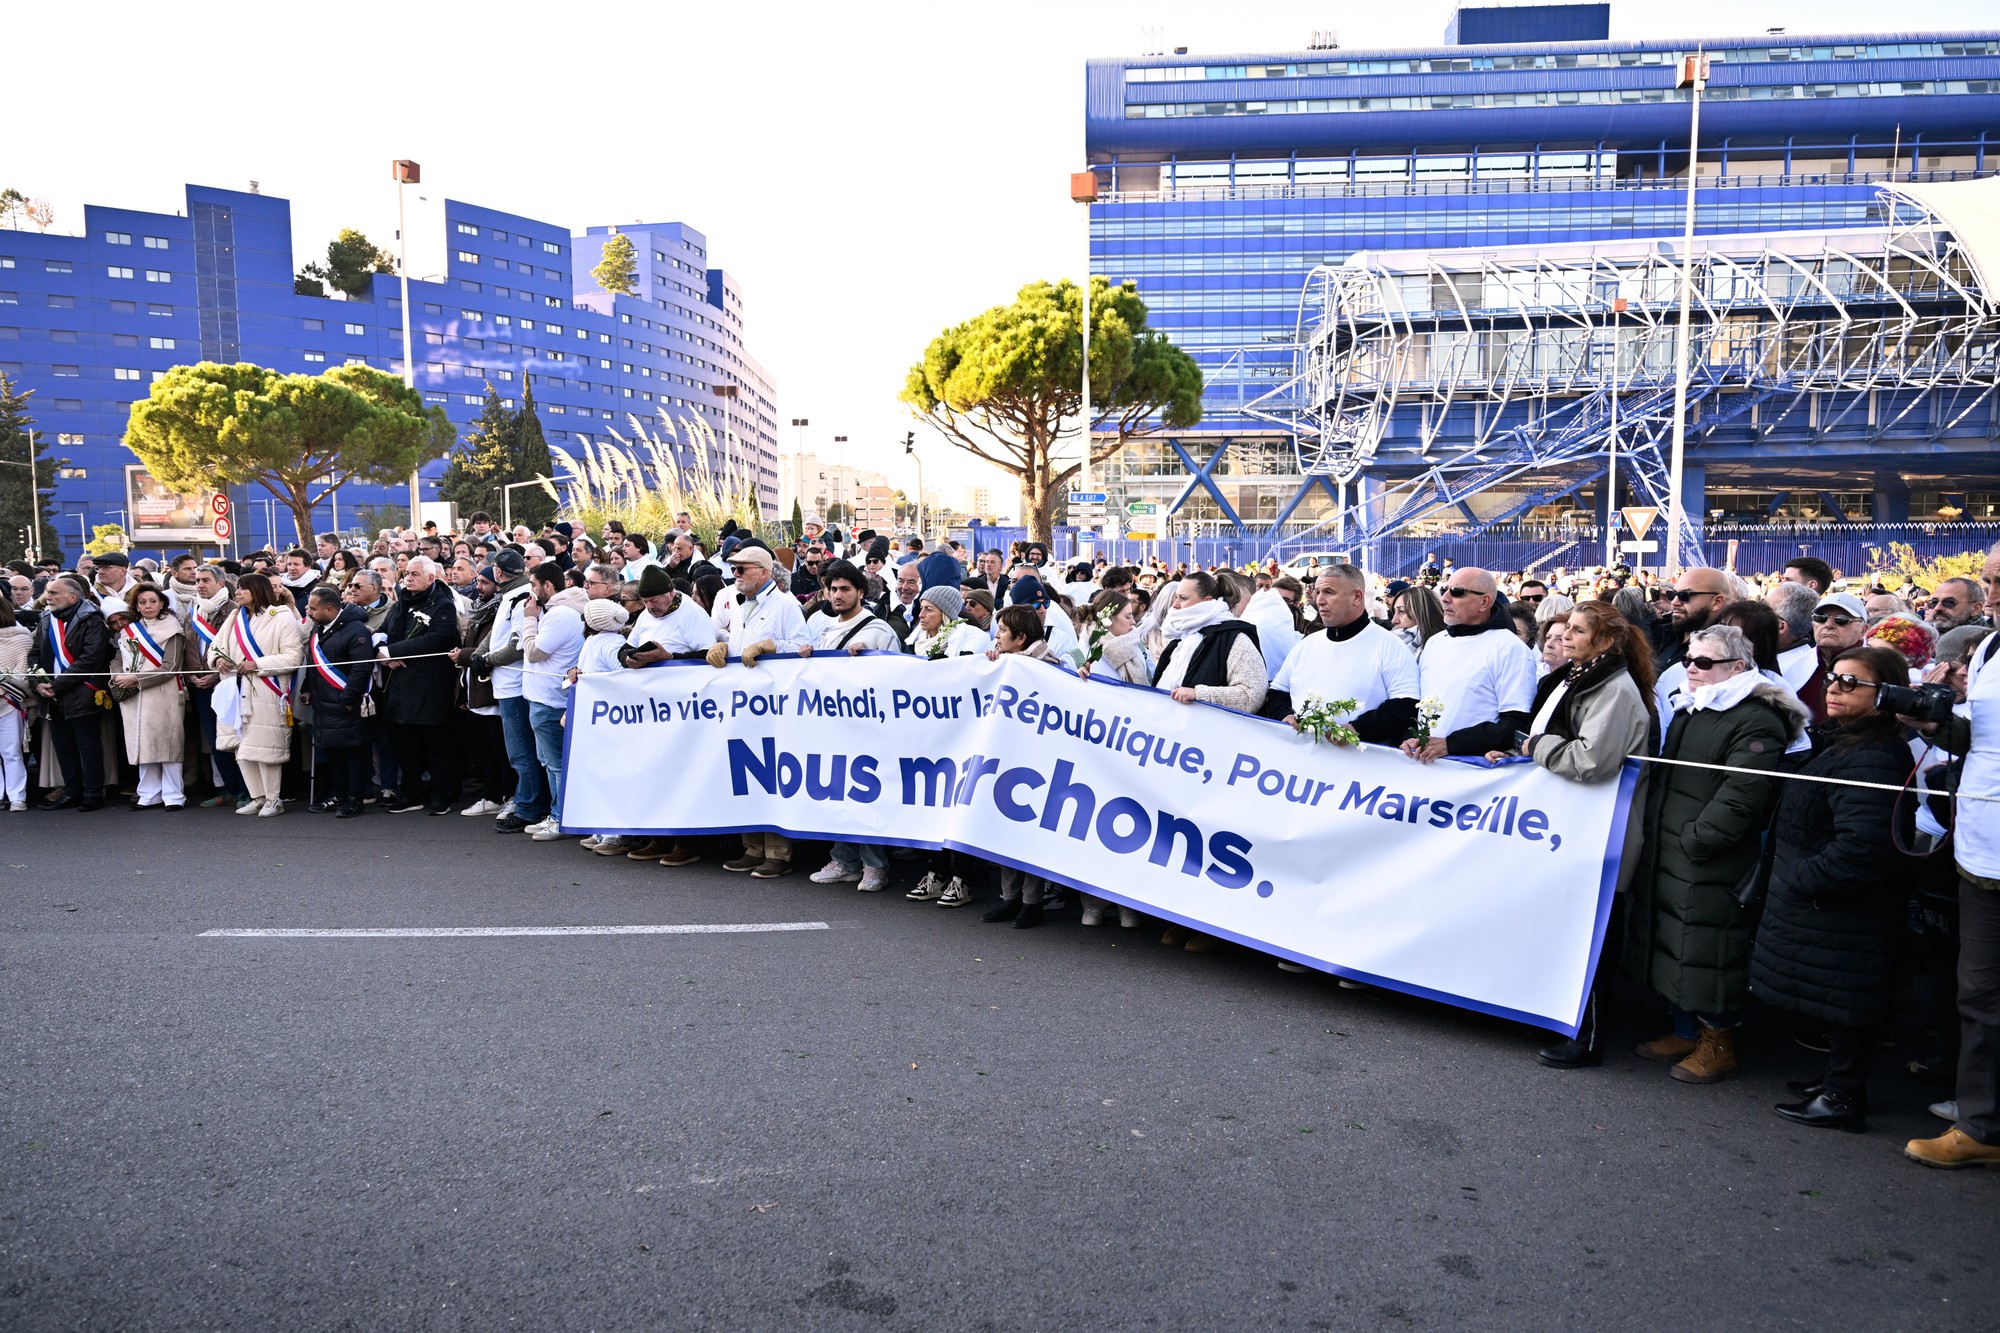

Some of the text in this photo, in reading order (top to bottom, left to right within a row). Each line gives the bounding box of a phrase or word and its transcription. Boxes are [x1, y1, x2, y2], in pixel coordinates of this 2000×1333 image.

[591, 700, 645, 725] Pour
[649, 697, 671, 722] la
[676, 691, 724, 723] vie,
[731, 690, 789, 717] Pour
[796, 687, 885, 723] Mehdi,
[892, 689, 962, 719] Pour
[991, 684, 1213, 784] République,
[1227, 753, 1335, 806] Pour
[1338, 780, 1562, 852] Marseille,
[727, 736, 882, 803] Nous
